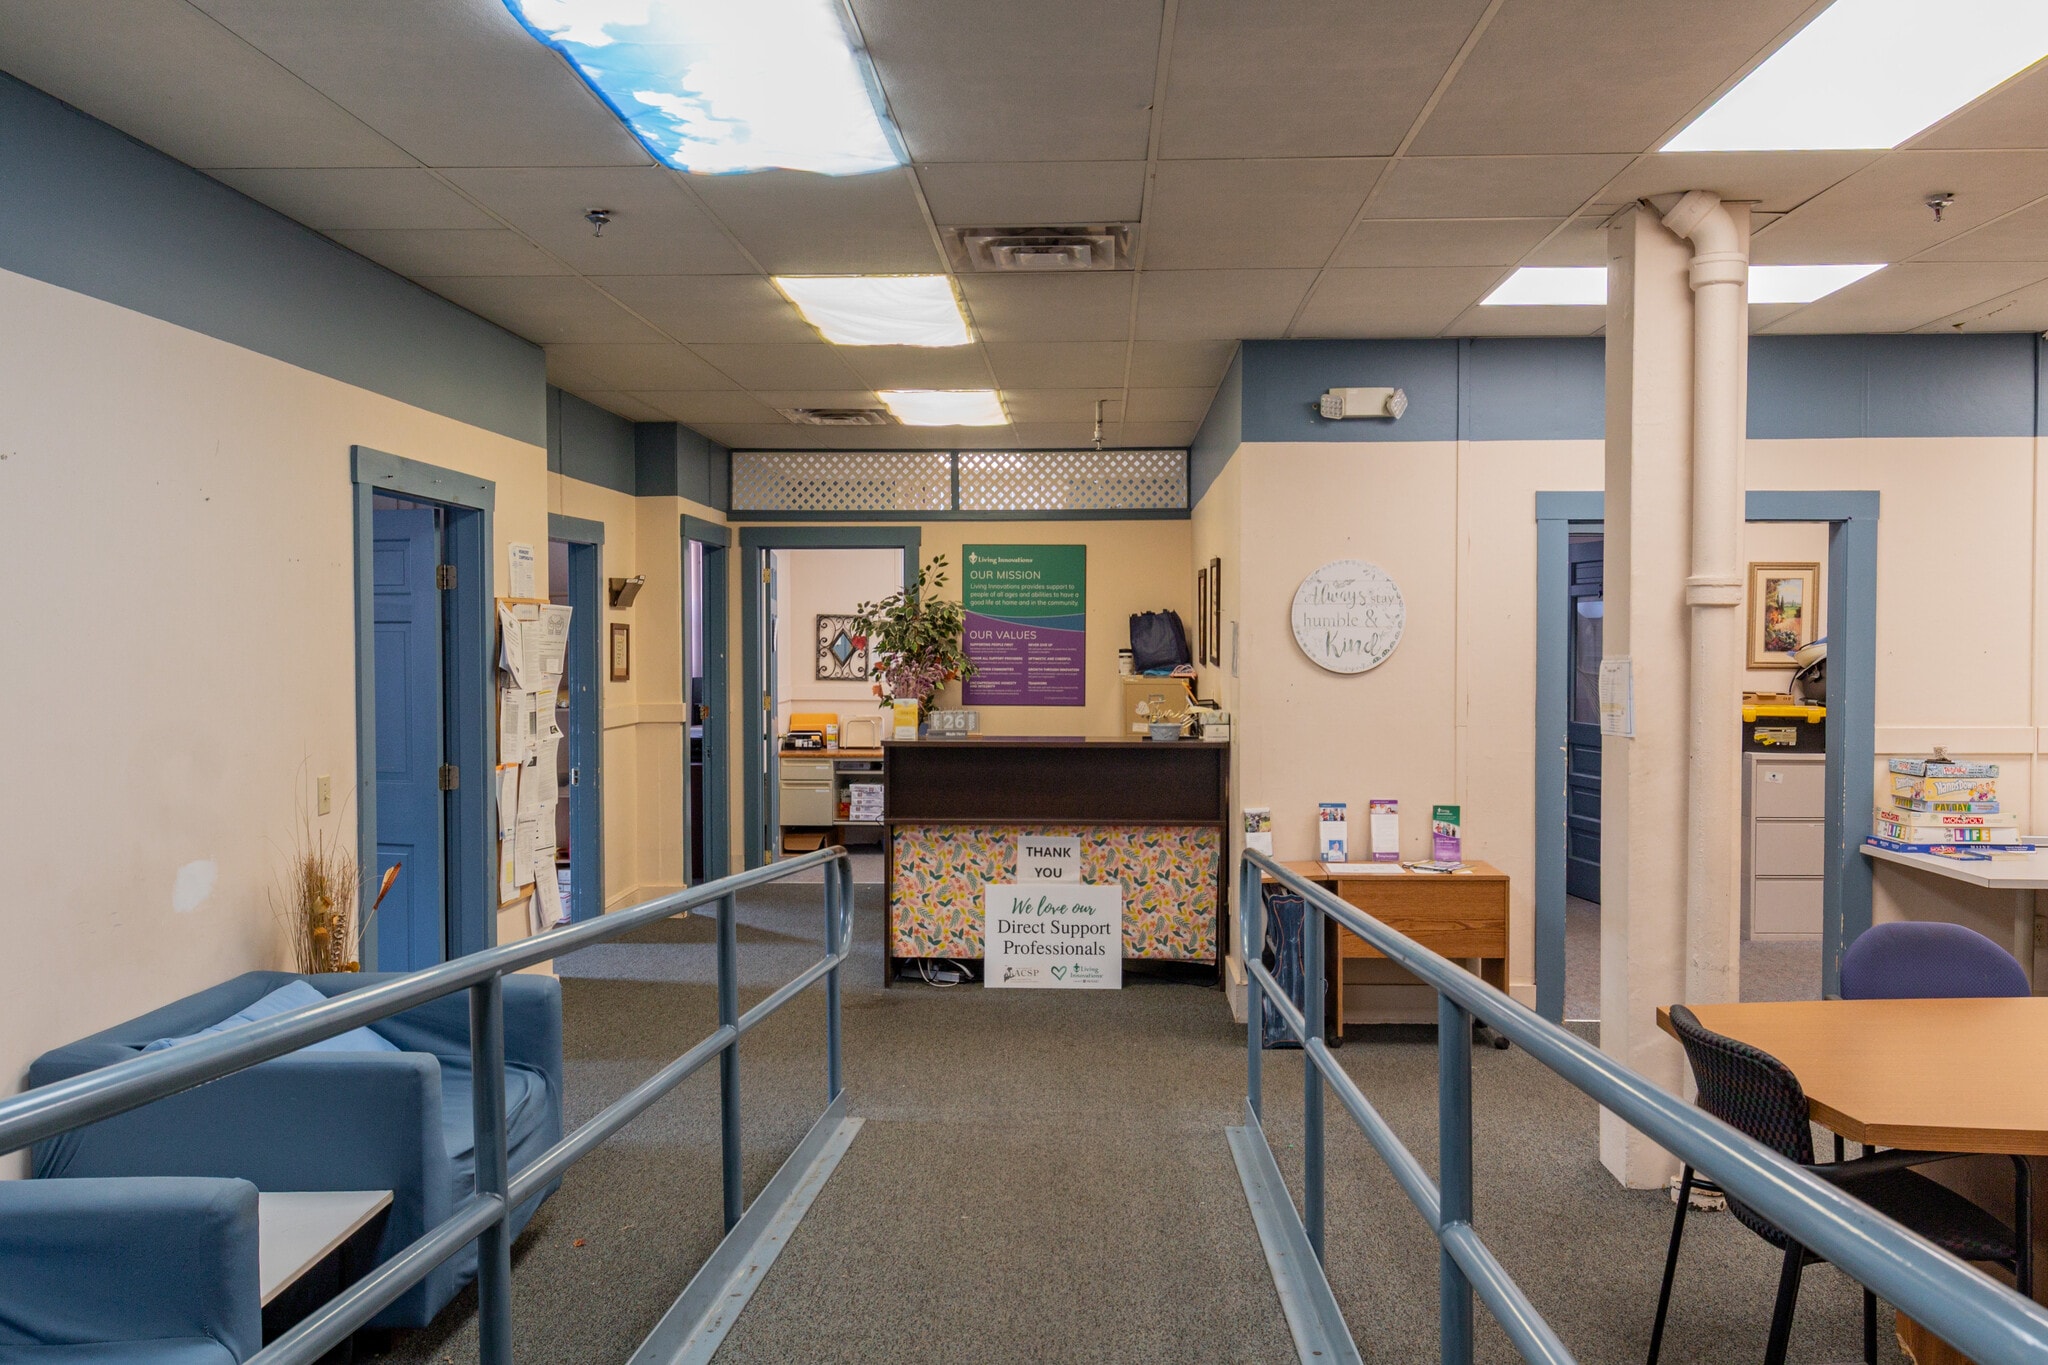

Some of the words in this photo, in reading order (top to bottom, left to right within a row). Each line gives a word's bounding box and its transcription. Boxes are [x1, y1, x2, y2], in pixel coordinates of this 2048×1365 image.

[979, 557, 997, 565] Living
[970, 570, 993, 580] OUR
[997, 570, 1041, 580] MISSION
[1304, 584, 1366, 610] Always
[1370, 594, 1395, 607] stay
[1303, 611, 1359, 628] humble
[1364, 608, 1378, 628] &
[969, 630, 993, 640] OUR
[995, 630, 1037, 640] VALUES
[1325, 630, 1381, 658] Kind
[943, 714, 965, 729] 26
[1955, 828, 1990, 841] LIFE
[1026, 846, 1072, 858] THANK
[1034, 867, 1062, 878] YOU
[1012, 897, 1033, 915] We
[1036, 895, 1068, 917] love
[1072, 903, 1096, 916] our
[998, 919, 1045, 934] Direct
[1050, 920, 1111, 938] Support
[1003, 940, 1106, 956] Professionals
[1014, 969, 1040, 977] ACSP
[1080, 966, 1099, 974] Living
